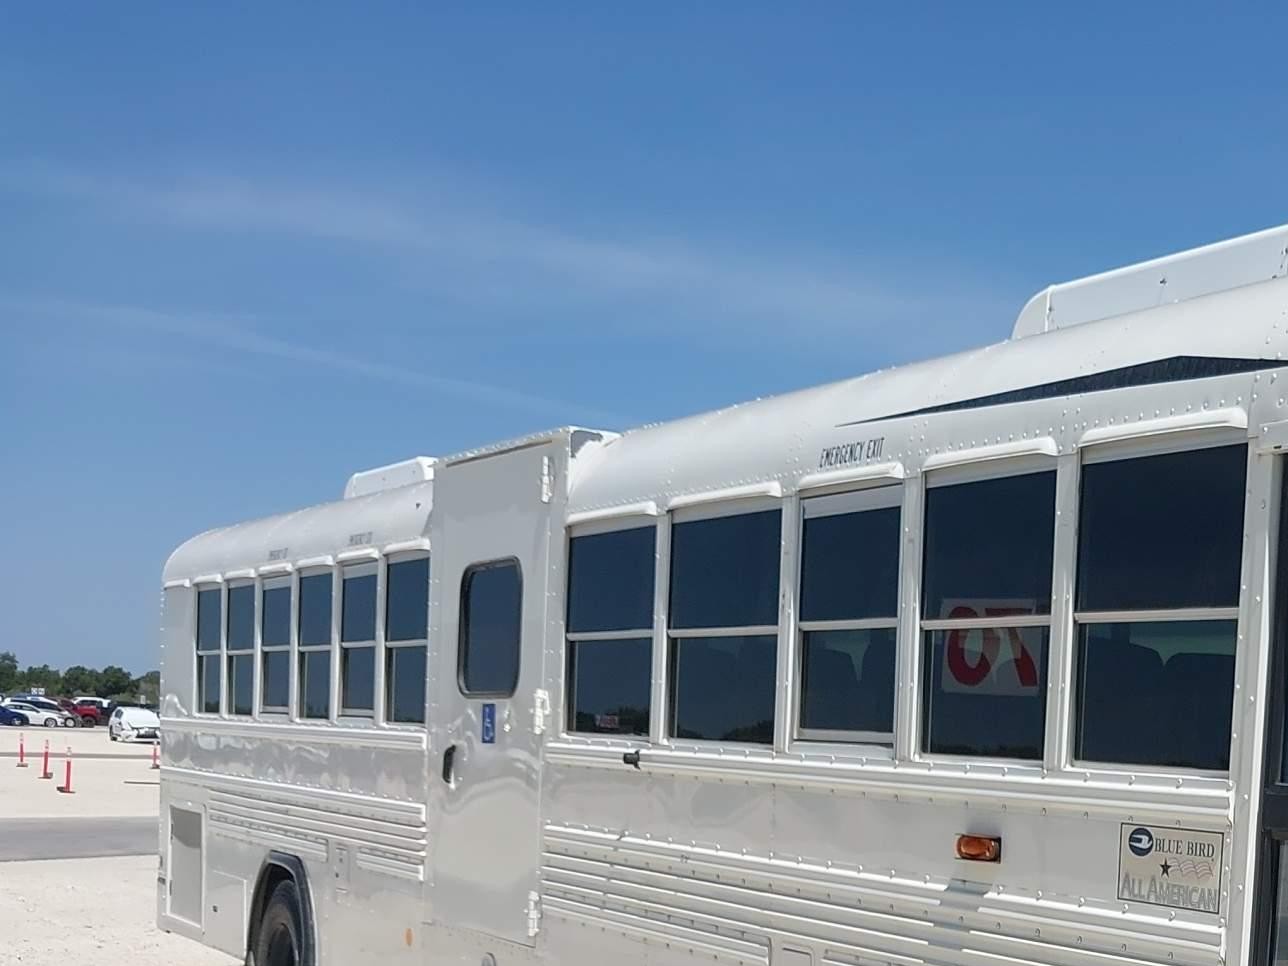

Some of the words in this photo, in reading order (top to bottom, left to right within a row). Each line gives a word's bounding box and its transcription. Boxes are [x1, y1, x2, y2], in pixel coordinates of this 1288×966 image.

[819, 440, 866, 469] EMERGENCY
[866, 436, 885, 460] EXIT
[1154, 837, 1183, 855] BLUE
[1186, 840, 1215, 859] BIRD
